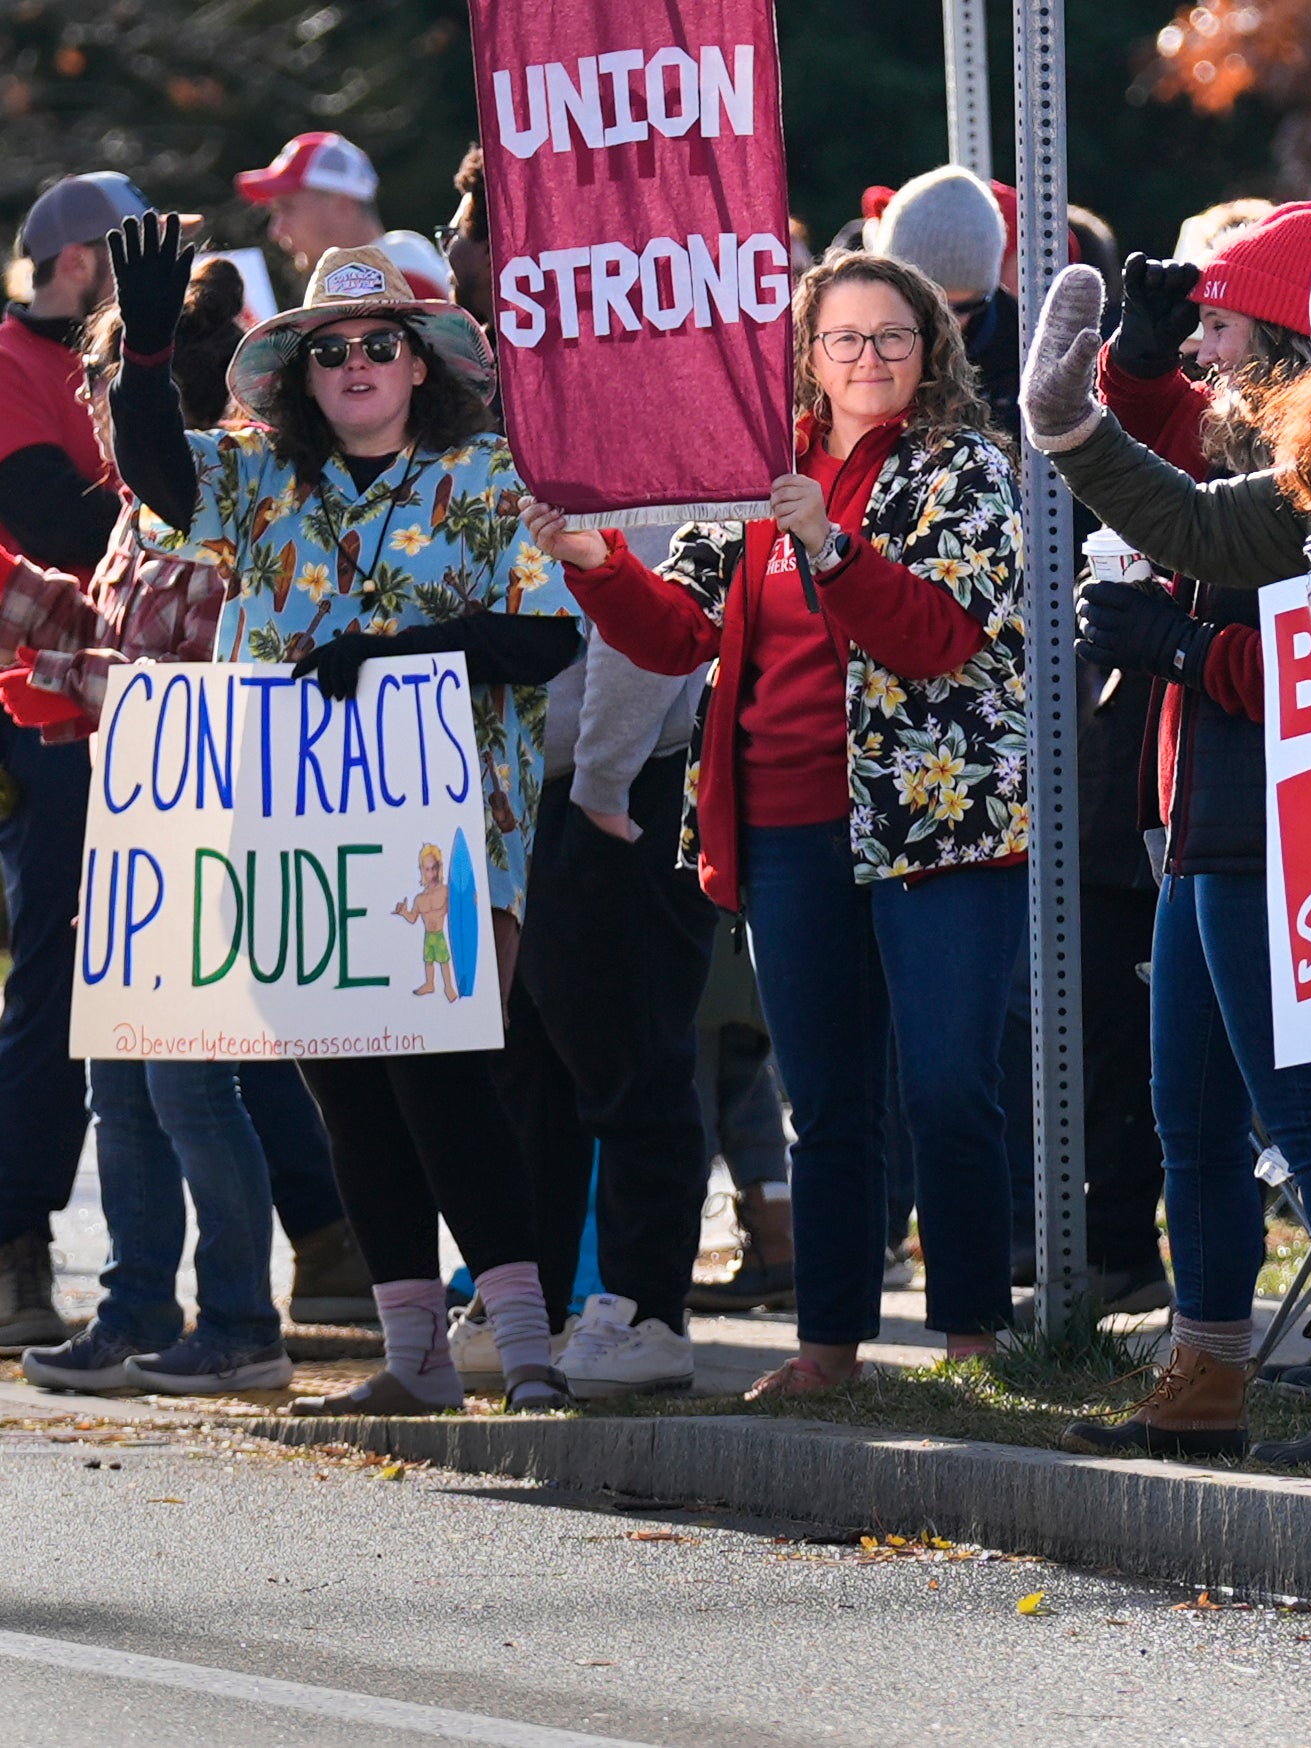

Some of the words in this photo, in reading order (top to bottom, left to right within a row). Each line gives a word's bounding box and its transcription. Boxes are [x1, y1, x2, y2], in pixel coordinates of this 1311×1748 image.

[493, 44, 754, 159] UNION
[500, 233, 790, 348] STRONG
[1203, 280, 1228, 299] SKI
[104, 658, 469, 817] CONTRACT'S
[82, 848, 164, 991] UP,
[192, 844, 390, 989] DUDE
[112, 1022, 426, 1061] @beverlyteachersassociation
